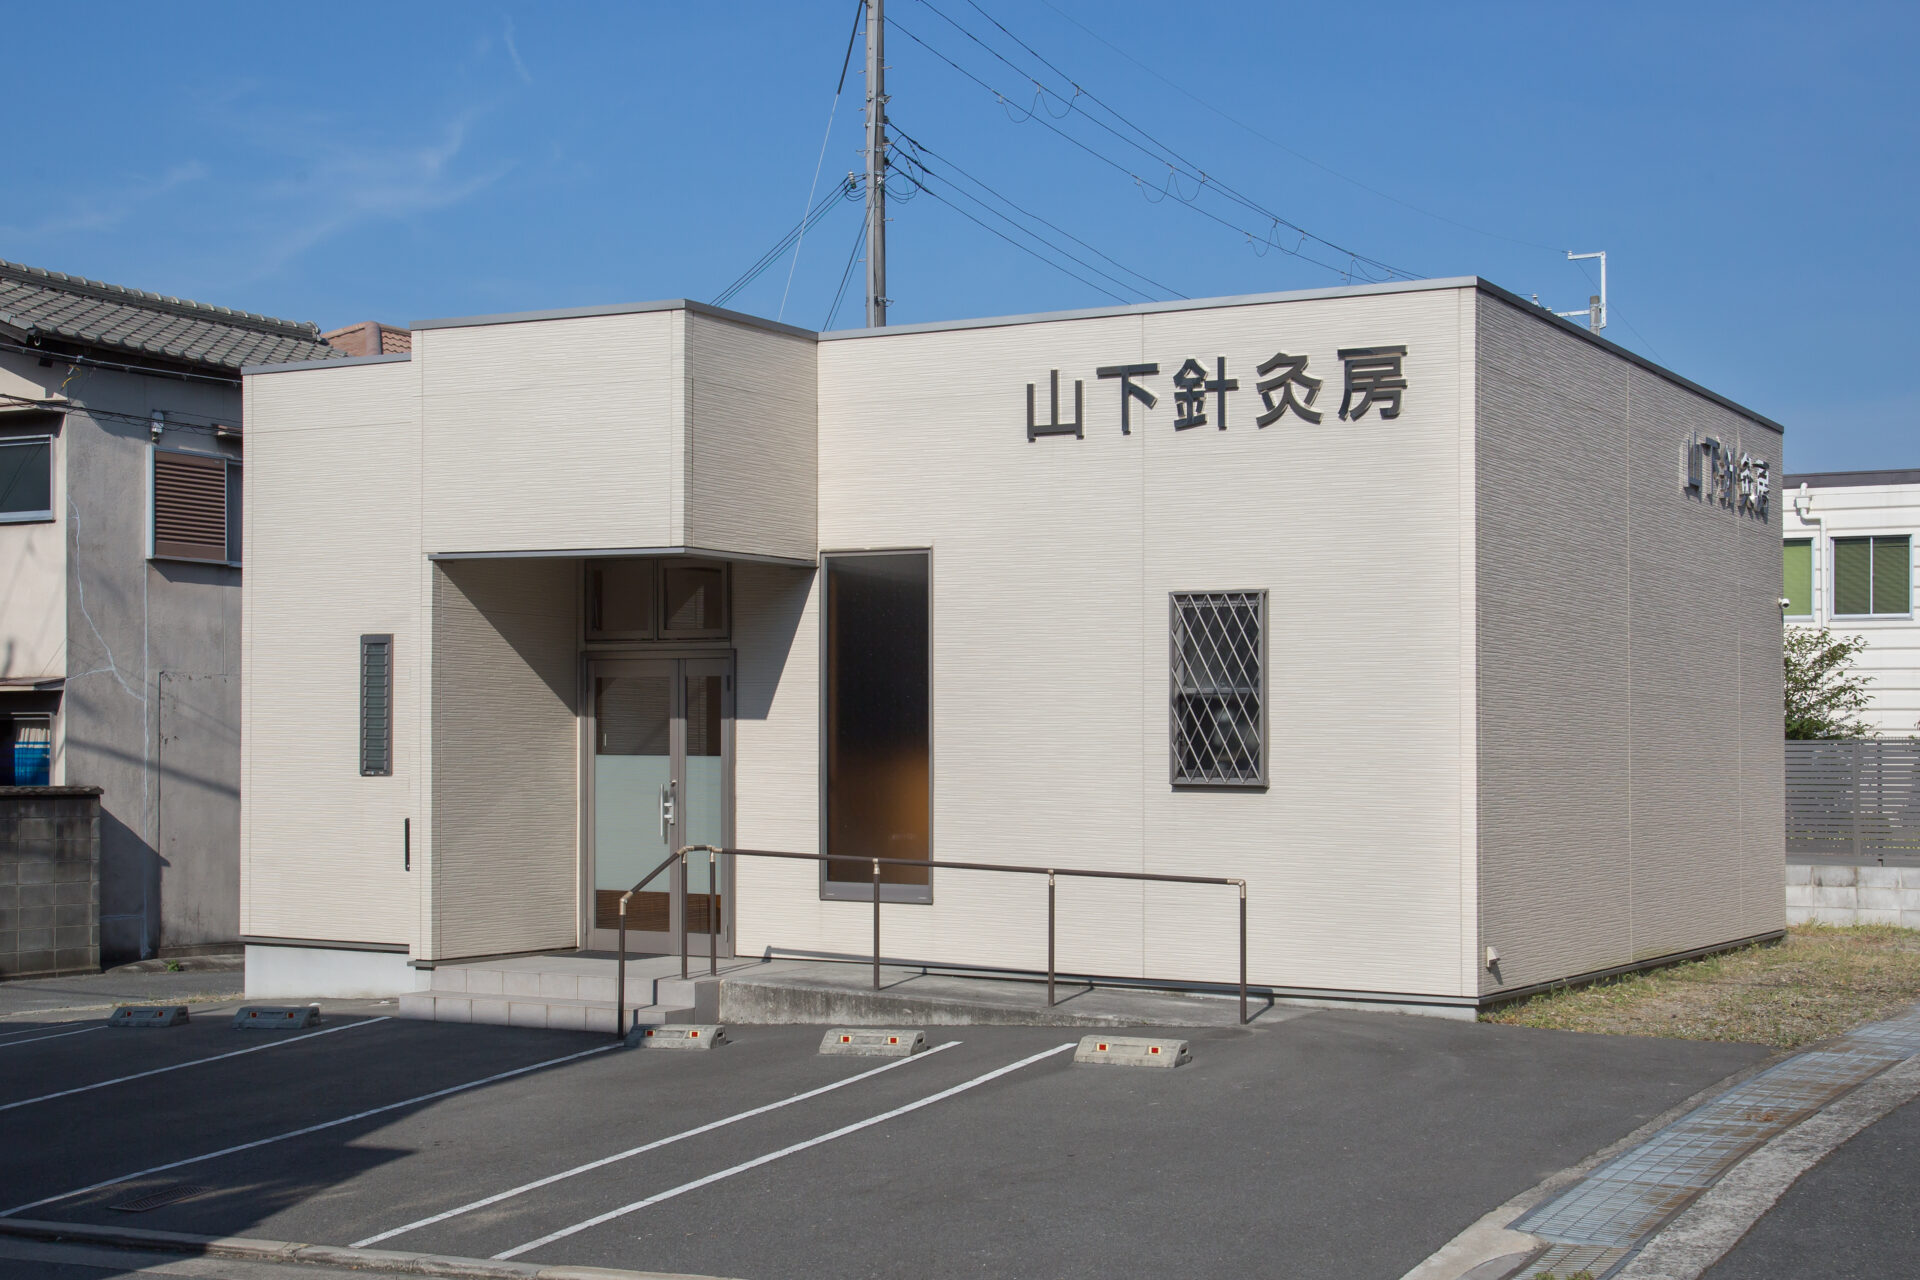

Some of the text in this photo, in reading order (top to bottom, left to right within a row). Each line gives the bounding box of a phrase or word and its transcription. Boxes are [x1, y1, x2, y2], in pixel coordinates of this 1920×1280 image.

[1026, 345, 1408, 442] 山下針灸房
